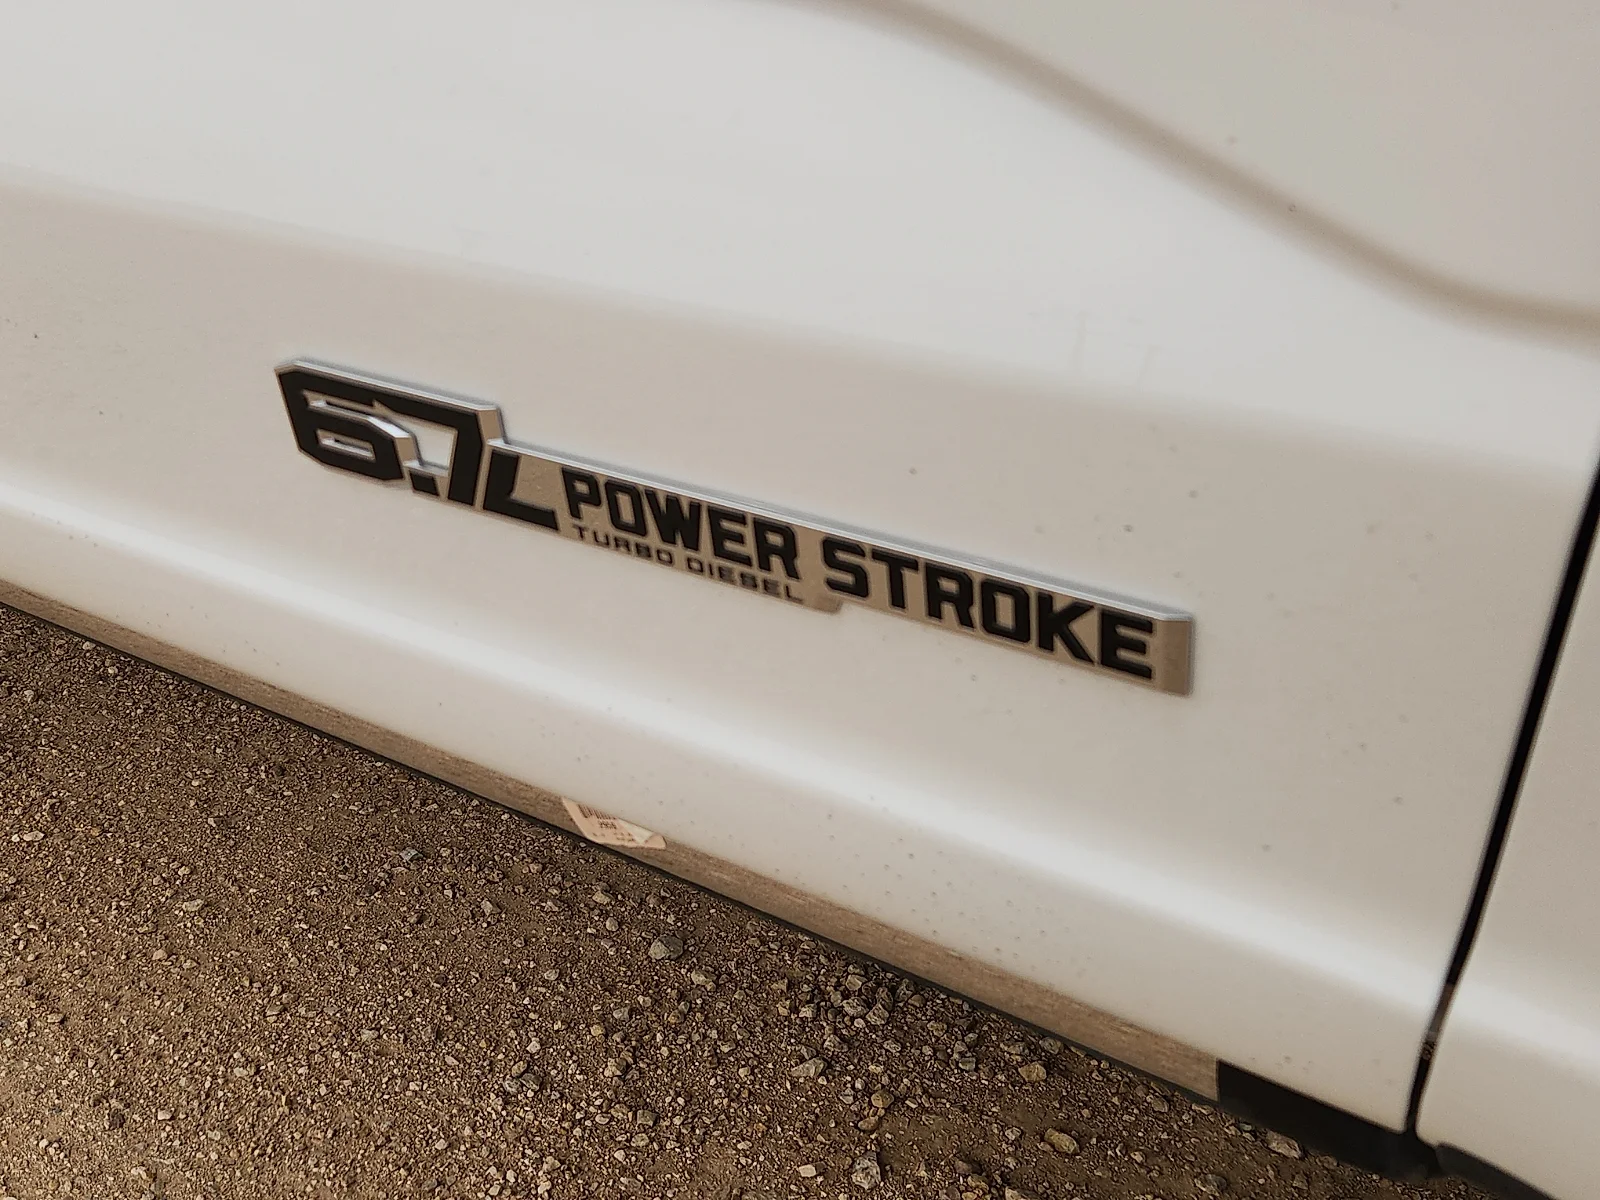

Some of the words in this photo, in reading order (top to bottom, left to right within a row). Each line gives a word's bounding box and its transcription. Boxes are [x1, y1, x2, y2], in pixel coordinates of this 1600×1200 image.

[278, 367, 558, 531] 6.7L
[562, 466, 801, 580] POWER
[822, 536, 1154, 680] STROKE
[573, 524, 672, 565] TURBO
[687, 556, 803, 604] DIESEL
